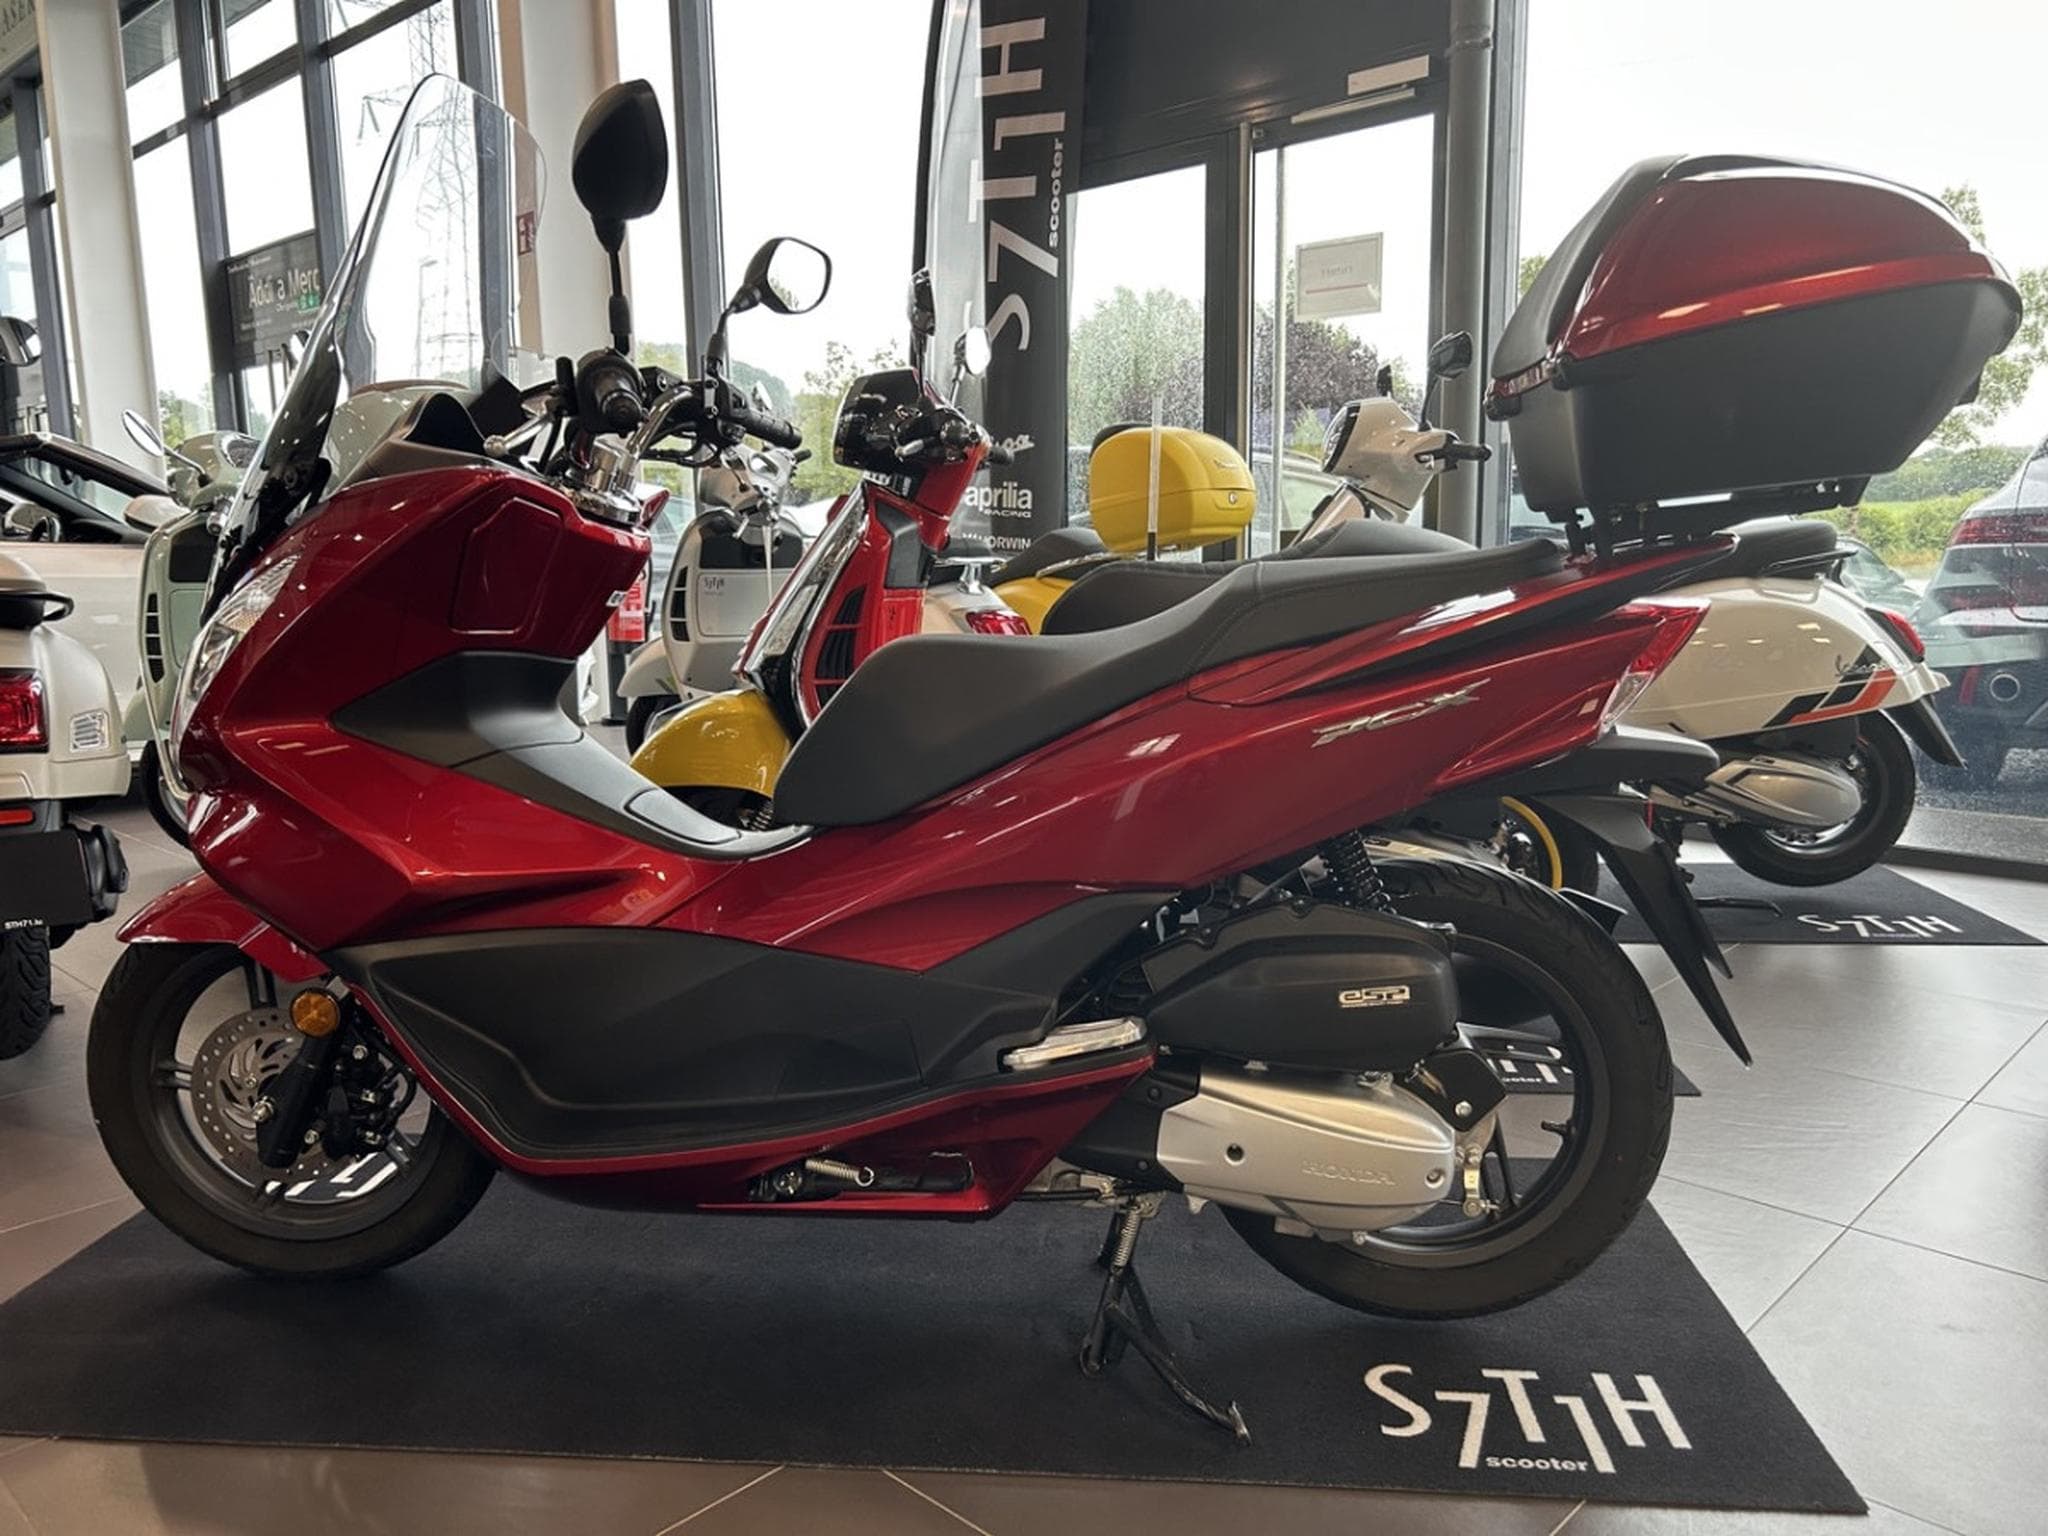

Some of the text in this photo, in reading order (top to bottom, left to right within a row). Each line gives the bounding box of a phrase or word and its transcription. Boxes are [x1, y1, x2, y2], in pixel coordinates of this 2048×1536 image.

[1049, 138, 1064, 248] scooter
[964, 481, 1033, 512] aprilia
[983, 509, 1032, 519] RACING
[1311, 677, 1491, 748] PCX
[1301, 1160, 1396, 1187] HONDA
[1485, 1455, 1589, 1473] scooter
